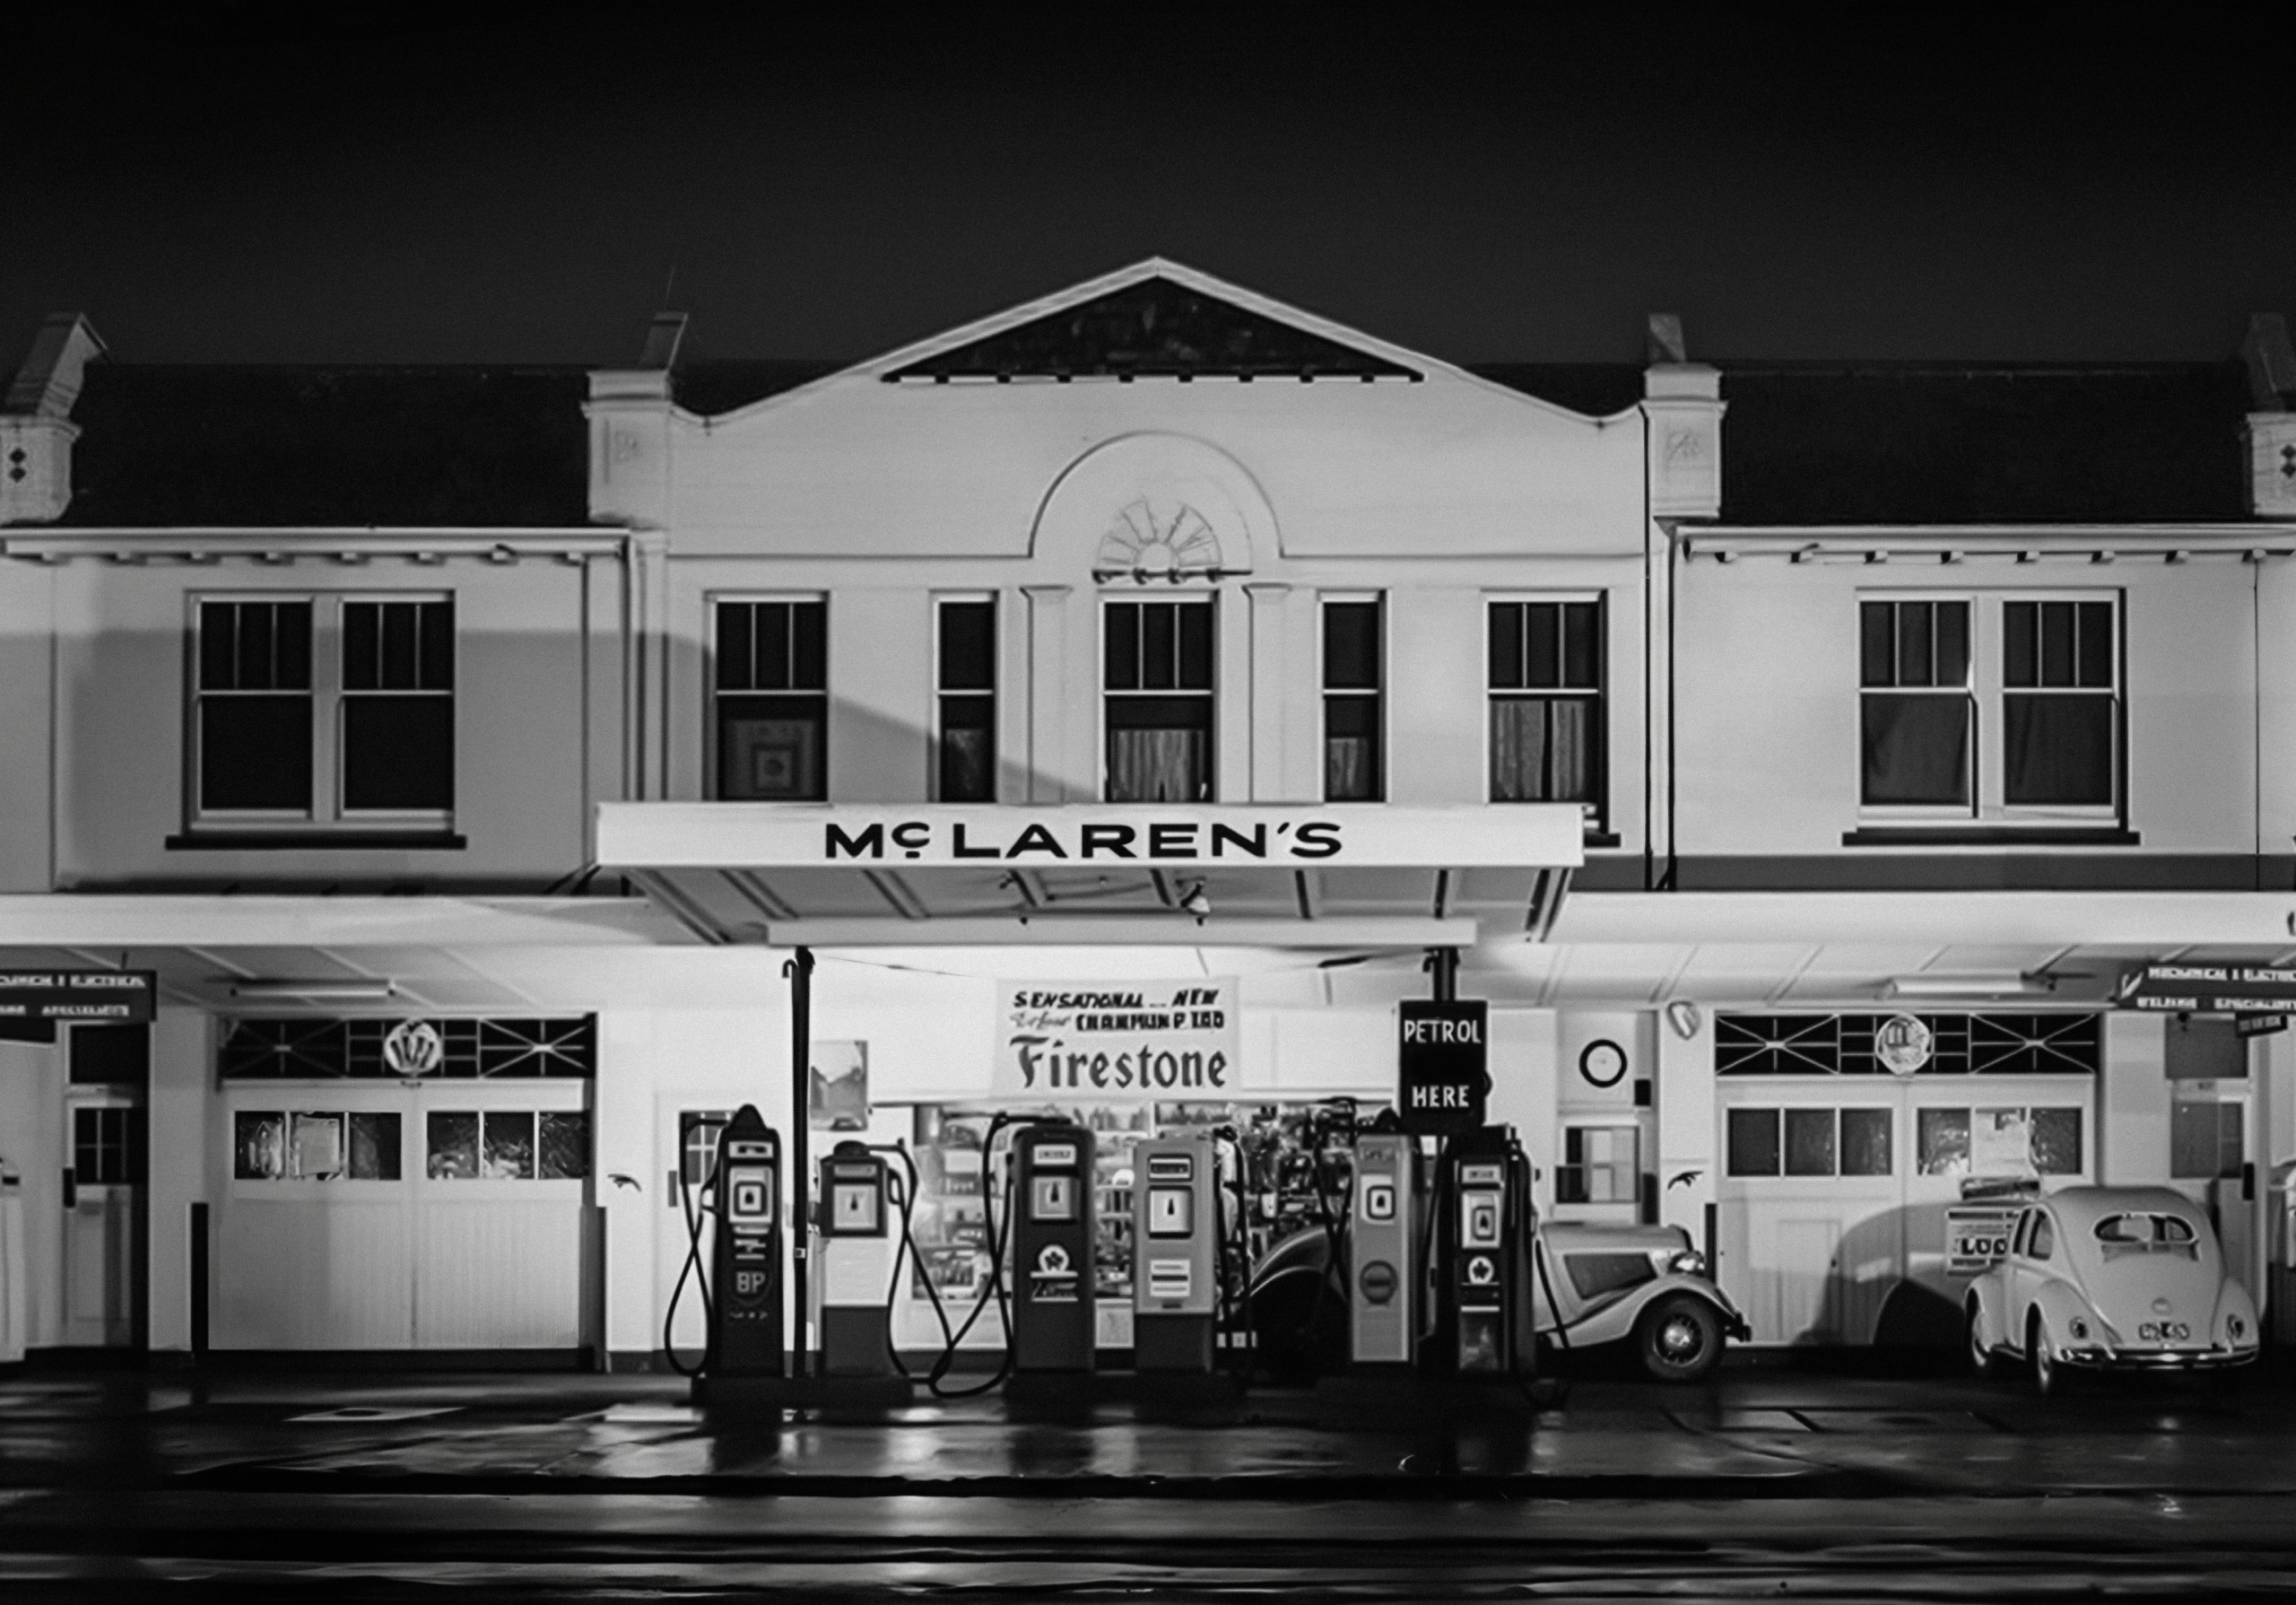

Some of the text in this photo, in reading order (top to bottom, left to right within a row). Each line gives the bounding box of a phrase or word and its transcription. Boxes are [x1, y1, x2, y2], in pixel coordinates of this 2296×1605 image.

[1013, 988, 1219, 1008] SENSATIONAL NEW
[1404, 1019, 1481, 1043] PETROL
[1009, 1034, 1227, 1089] Firestone
[1412, 1085, 1470, 1108] HERE
[736, 1270, 766, 1294] BP
